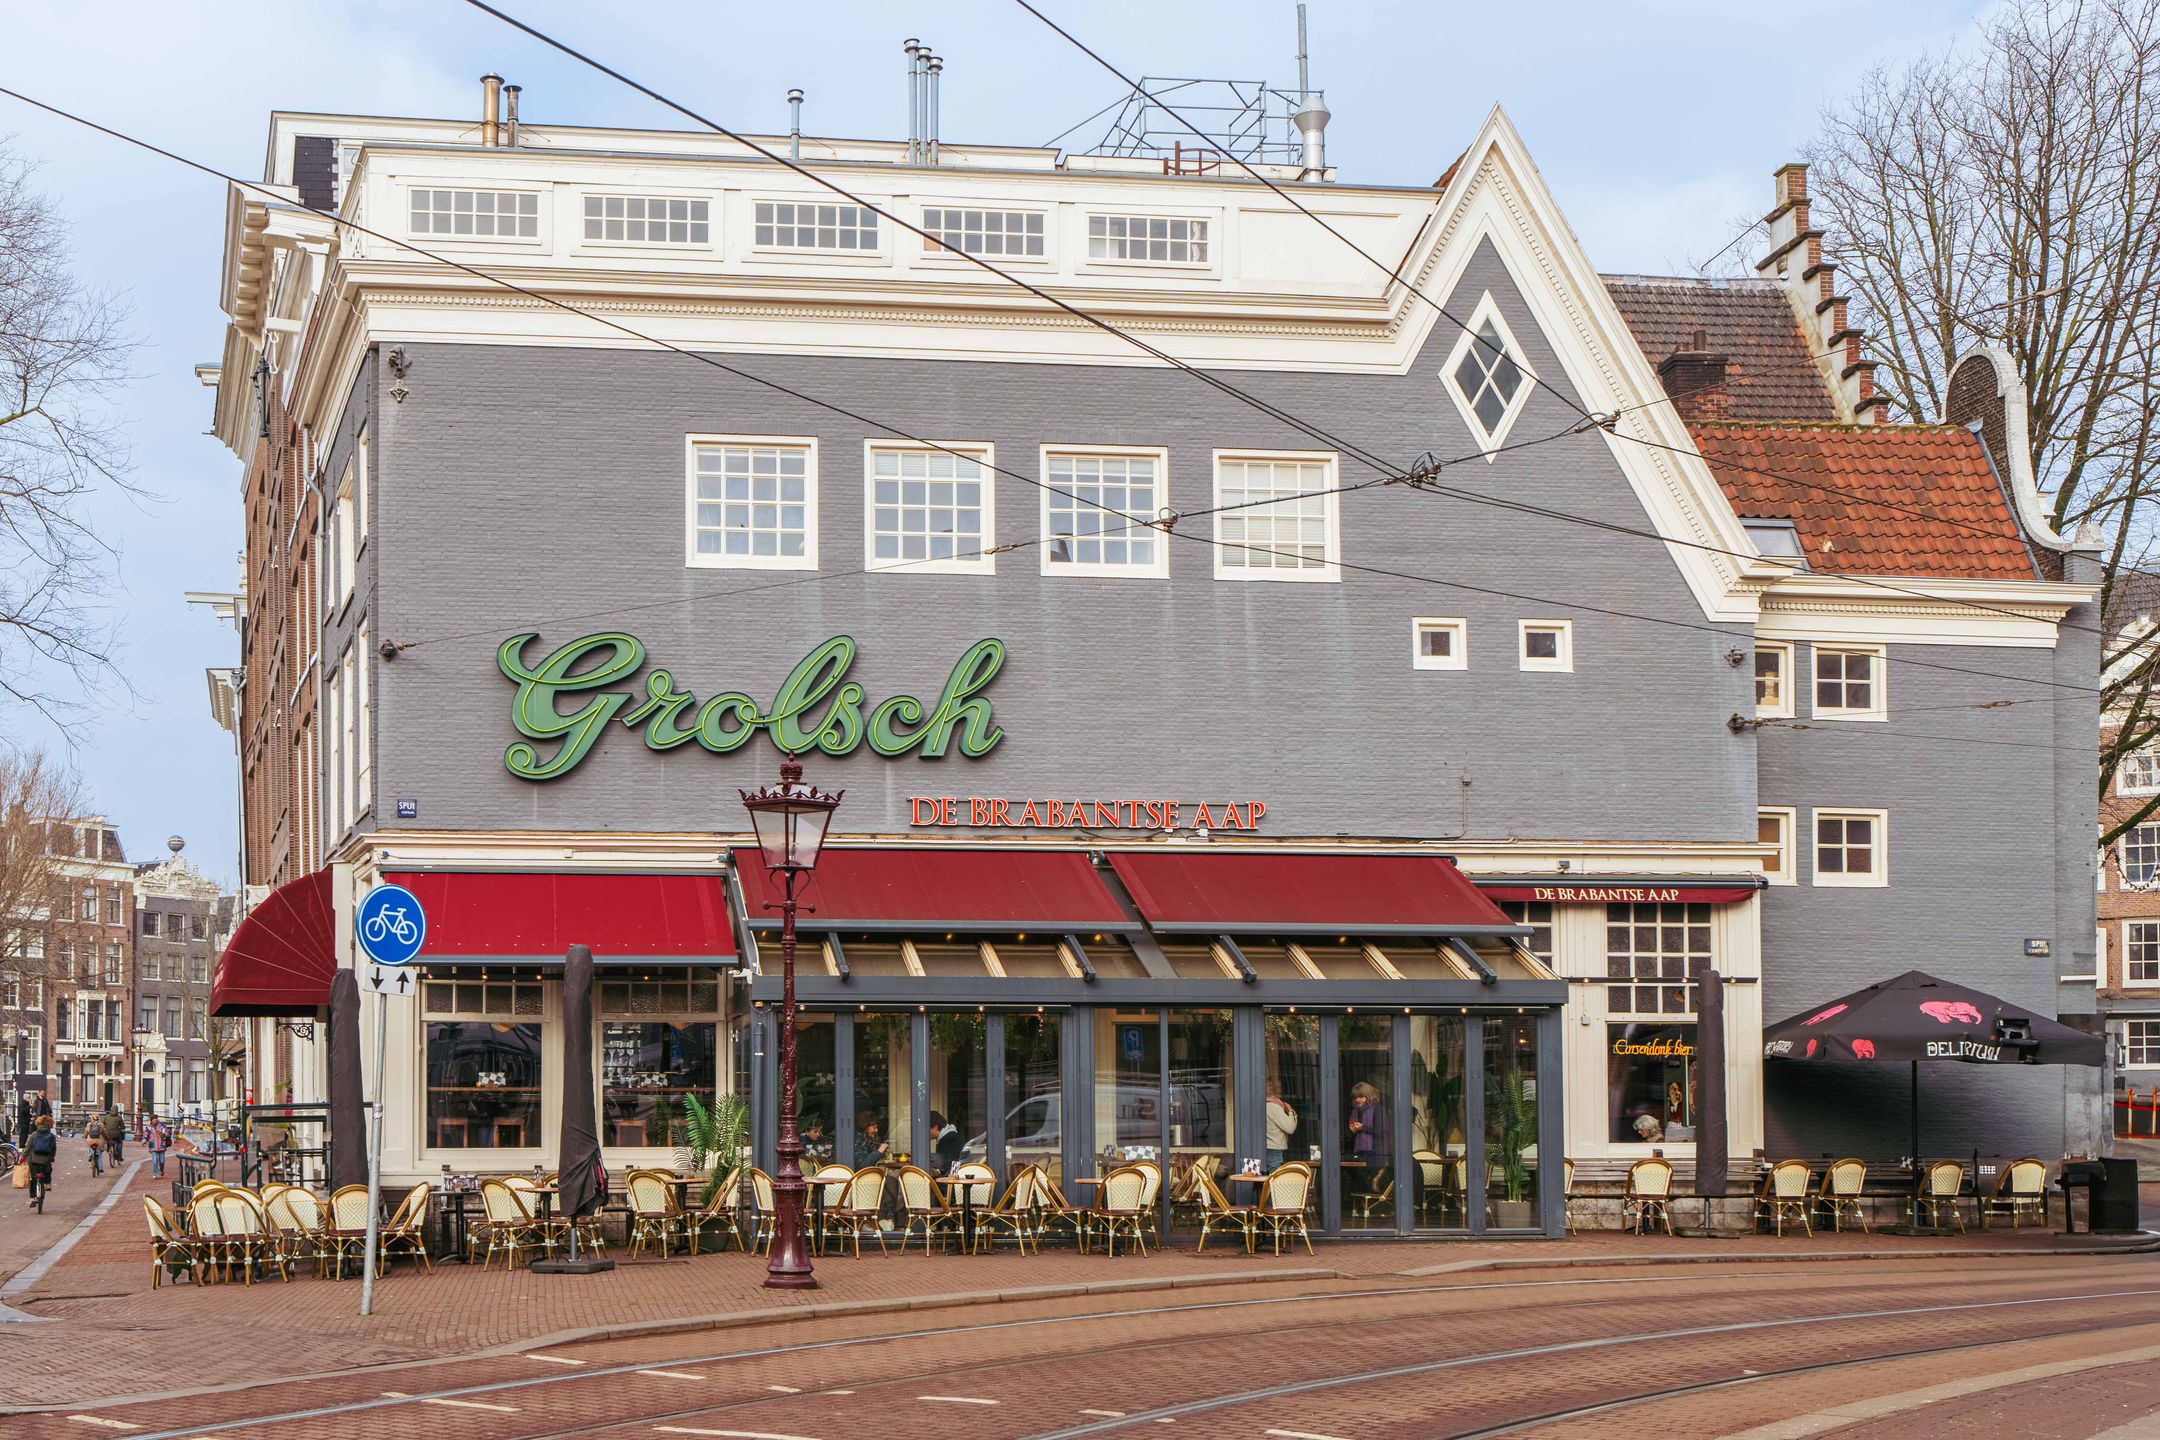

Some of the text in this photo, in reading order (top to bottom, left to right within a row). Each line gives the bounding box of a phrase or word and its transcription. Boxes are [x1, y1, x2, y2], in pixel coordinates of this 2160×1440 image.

[497, 632, 1007, 781] Grolsch
[398, 801, 416, 810] SPUI
[910, 797, 1266, 830] DE BRABANTSE AAP
[1534, 887, 1680, 901] DE BRABANTSE AAP
[1615, 1038, 1691, 1056] Corsendonk bier
